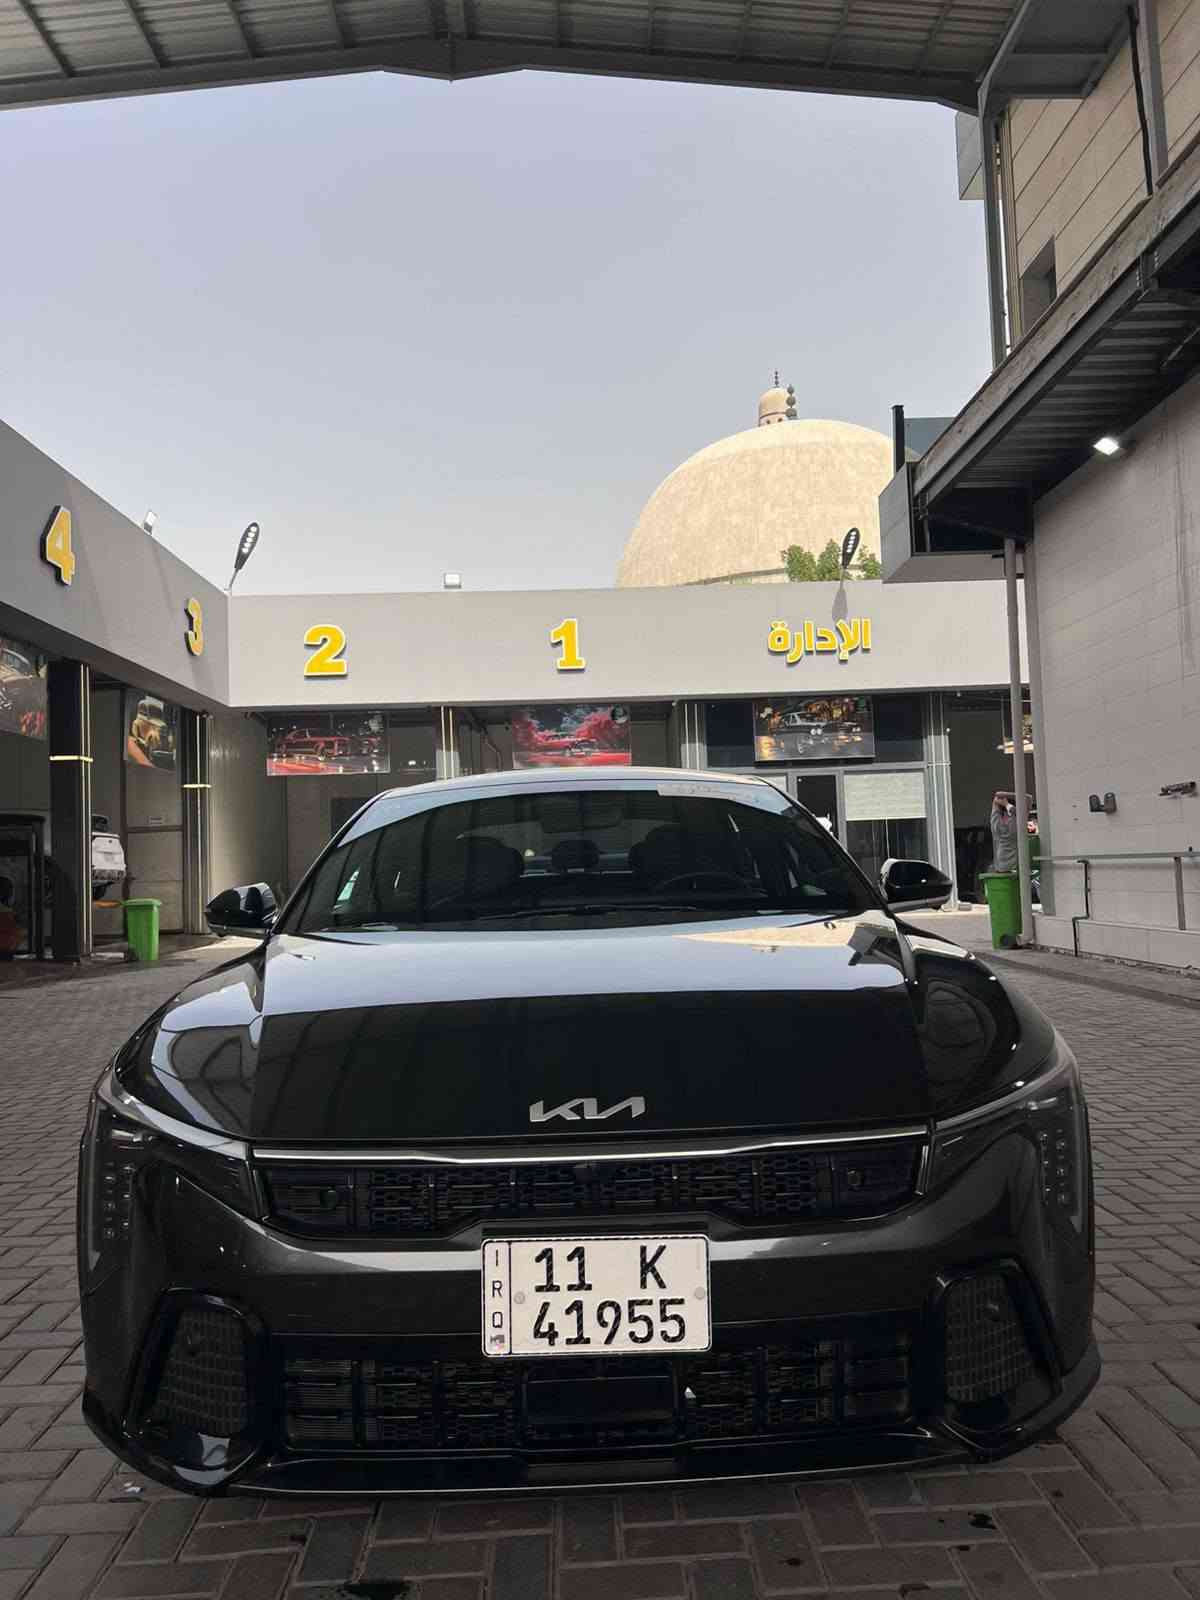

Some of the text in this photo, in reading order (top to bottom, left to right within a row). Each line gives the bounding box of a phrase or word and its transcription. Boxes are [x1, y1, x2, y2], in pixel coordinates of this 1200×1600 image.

[41, 504, 76, 586] 4
[184, 598, 204, 657] 3
[303, 623, 348, 678] 2
[549, 618, 586, 671] 1
[767, 617, 872, 664] الإدارة
[529, 1096, 646, 1123] KIA
[534, 1244, 667, 1293] 11 K
[533, 1297, 686, 1347] 41955
